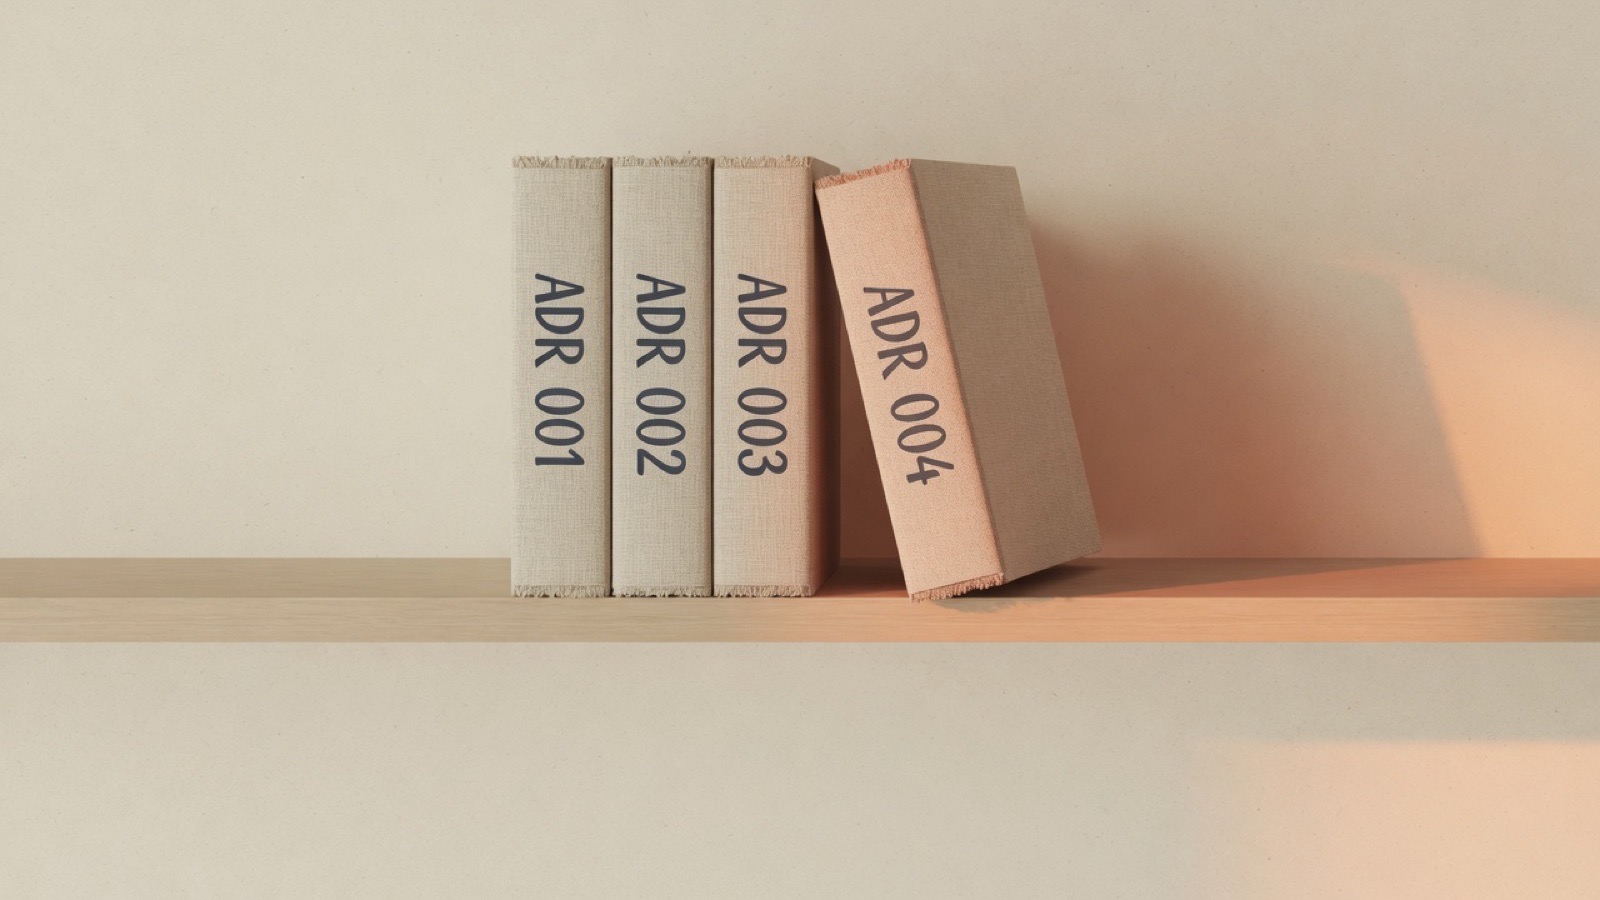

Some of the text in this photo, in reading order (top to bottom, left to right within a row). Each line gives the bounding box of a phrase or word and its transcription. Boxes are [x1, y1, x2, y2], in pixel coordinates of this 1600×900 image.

[534, 273, 585, 467] ADR 001
[635, 273, 687, 476] ADR 002
[737, 273, 788, 477] ADR 003
[863, 286, 955, 486] ADR 004
